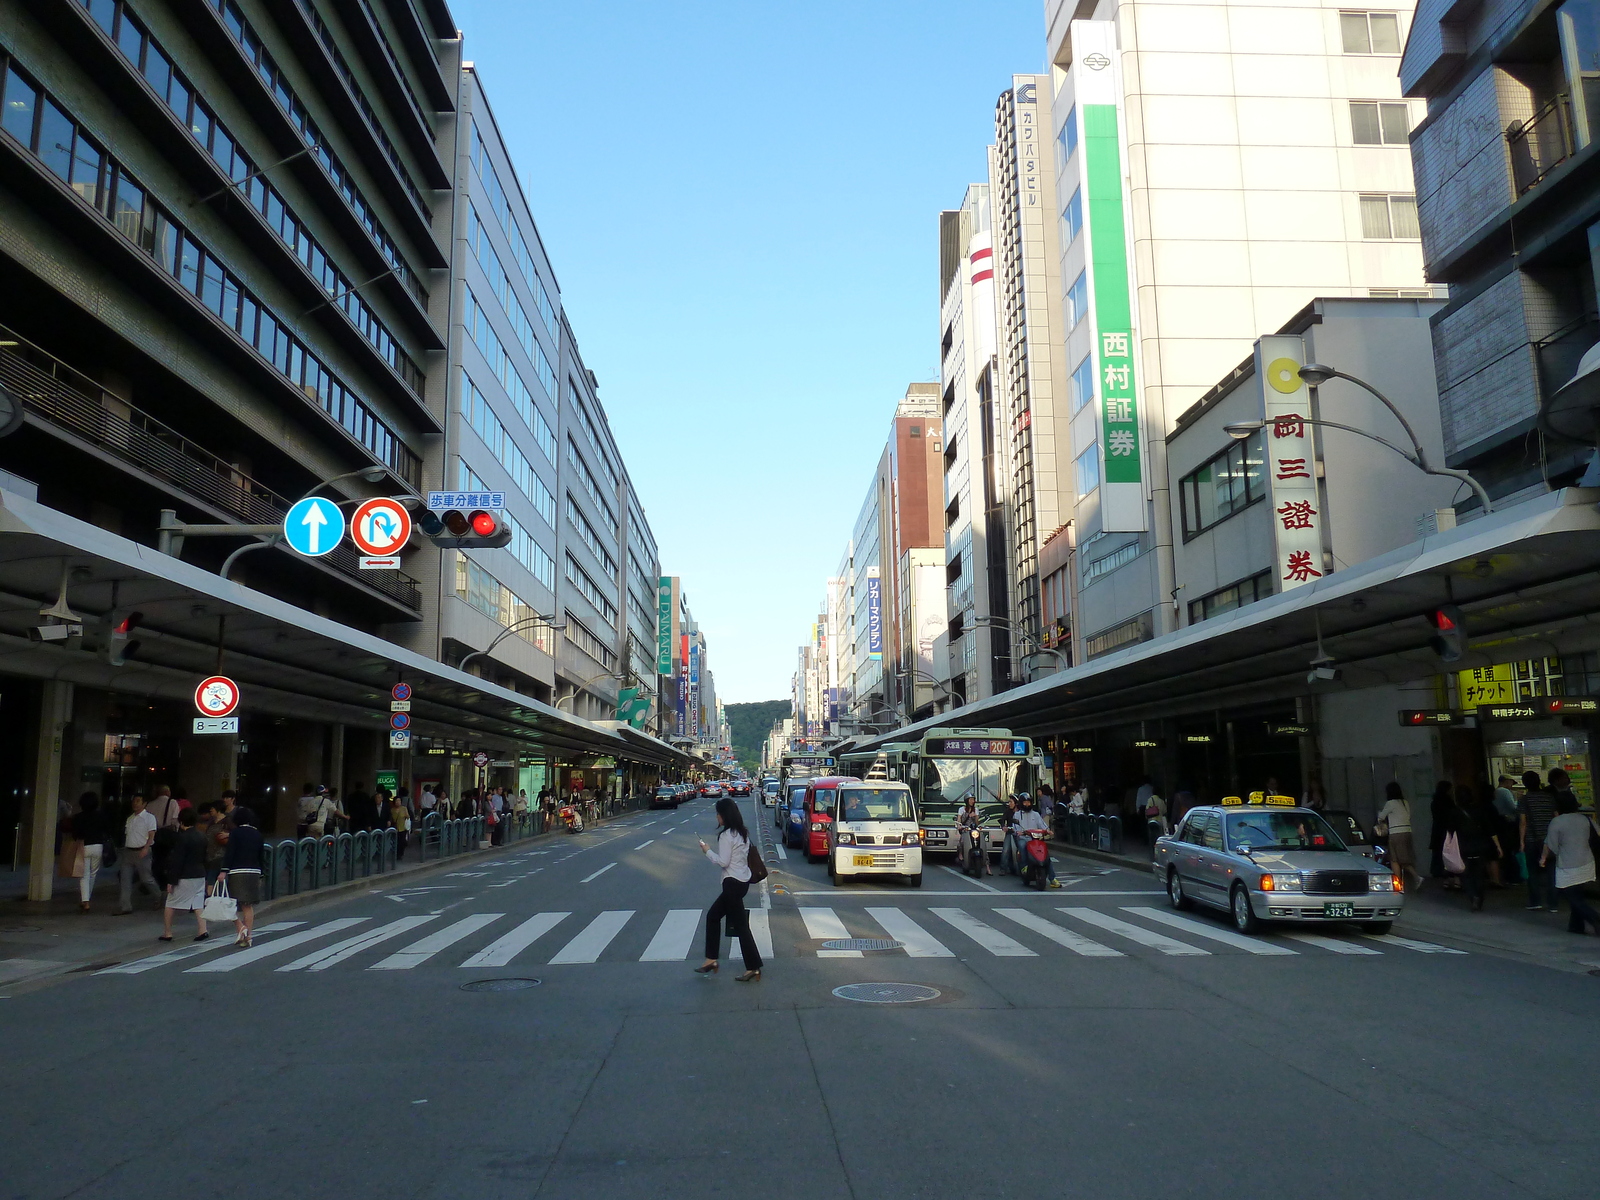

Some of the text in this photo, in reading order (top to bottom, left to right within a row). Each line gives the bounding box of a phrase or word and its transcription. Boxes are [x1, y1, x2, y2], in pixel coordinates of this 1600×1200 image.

[1023, 111, 1036, 206] カワバタビル
[1102, 331, 1136, 457] 西村証券
[431, 494, 503, 507] 歩車分離信号
[869, 581, 880, 649] リカーマウンテン
[660, 602, 670, 665] DAIMARU
[1466, 682, 1506, 702] チケット
[1491, 707, 1535, 718] 甲南チケット
[991, 741, 1008, 753] 207
[1330, 907, 1353, 917] 32-43
